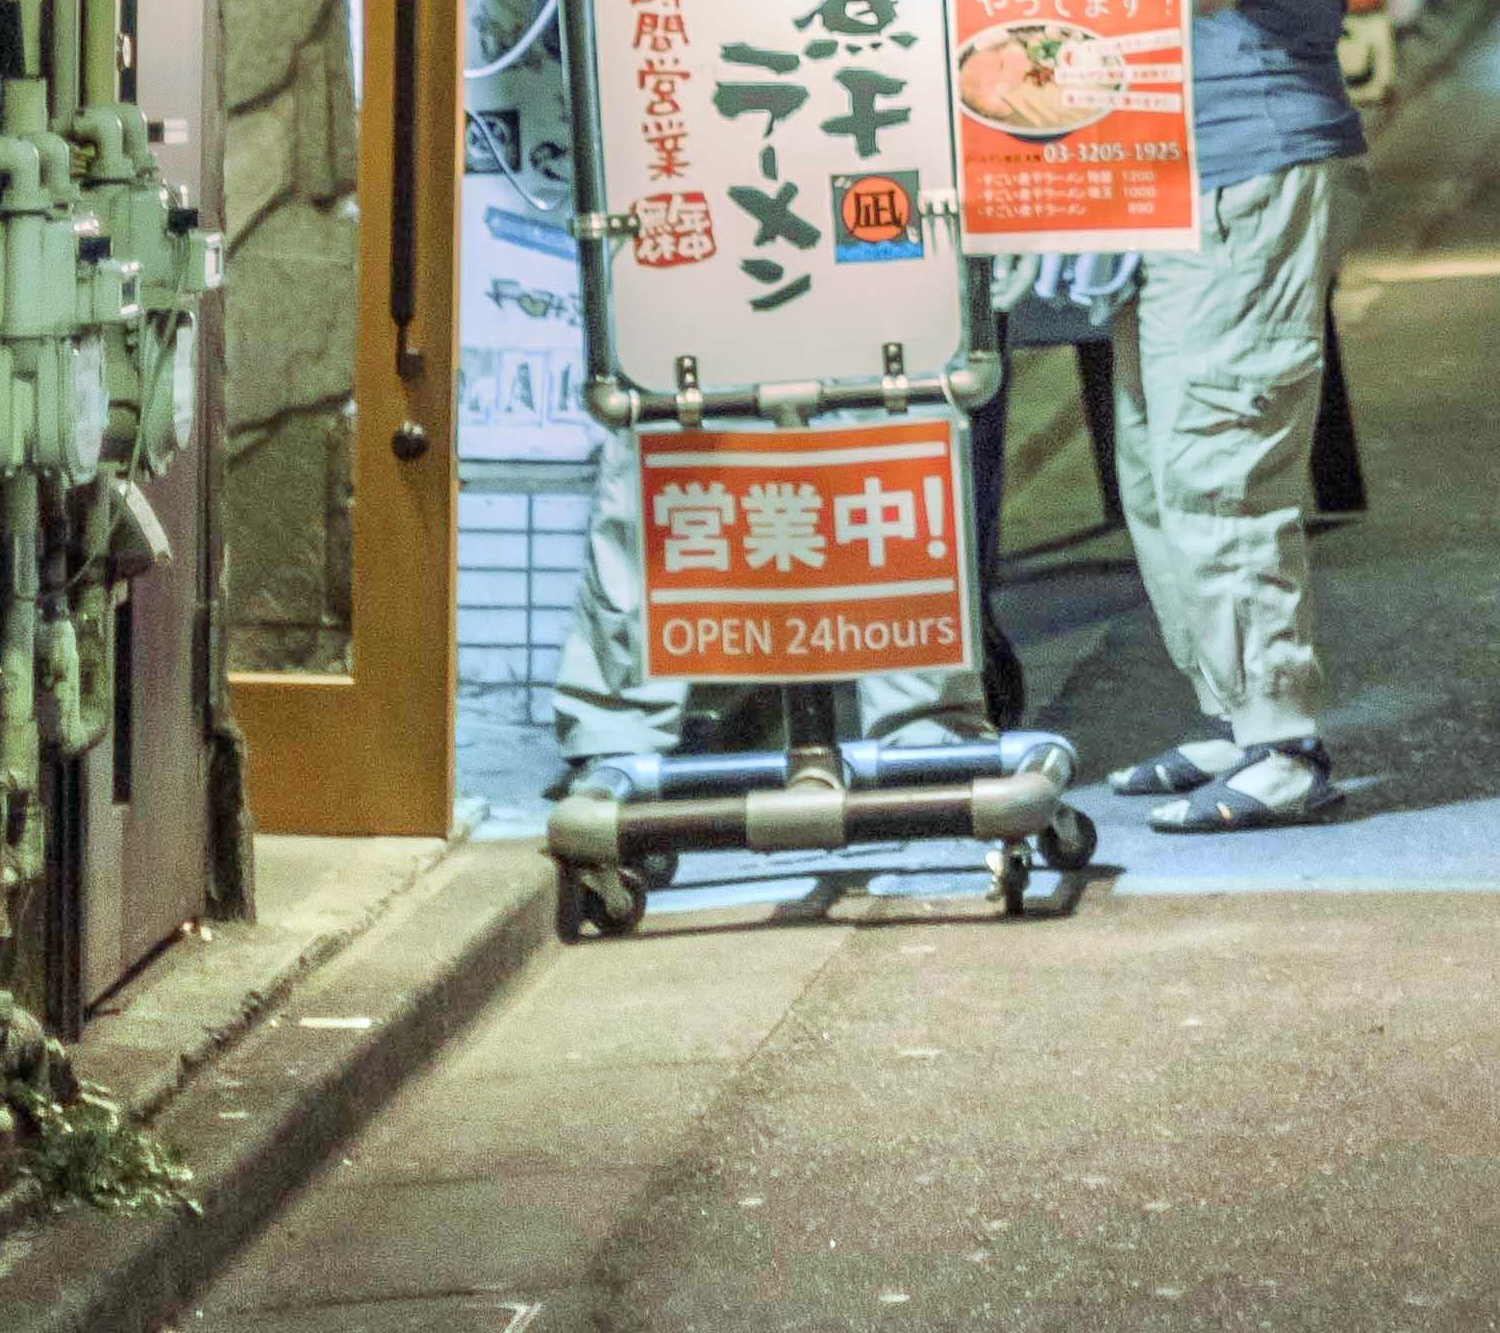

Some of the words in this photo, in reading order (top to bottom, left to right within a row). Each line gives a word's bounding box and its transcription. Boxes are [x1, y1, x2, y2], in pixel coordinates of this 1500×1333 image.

[712, 42, 821, 311] ラーメン
[1043, 141, 1180, 163] 03-3205-1925
[653, 475, 947, 573] 営業中!
[662, 617, 772, 656] OPEN
[786, 614, 956, 655] 24hours
